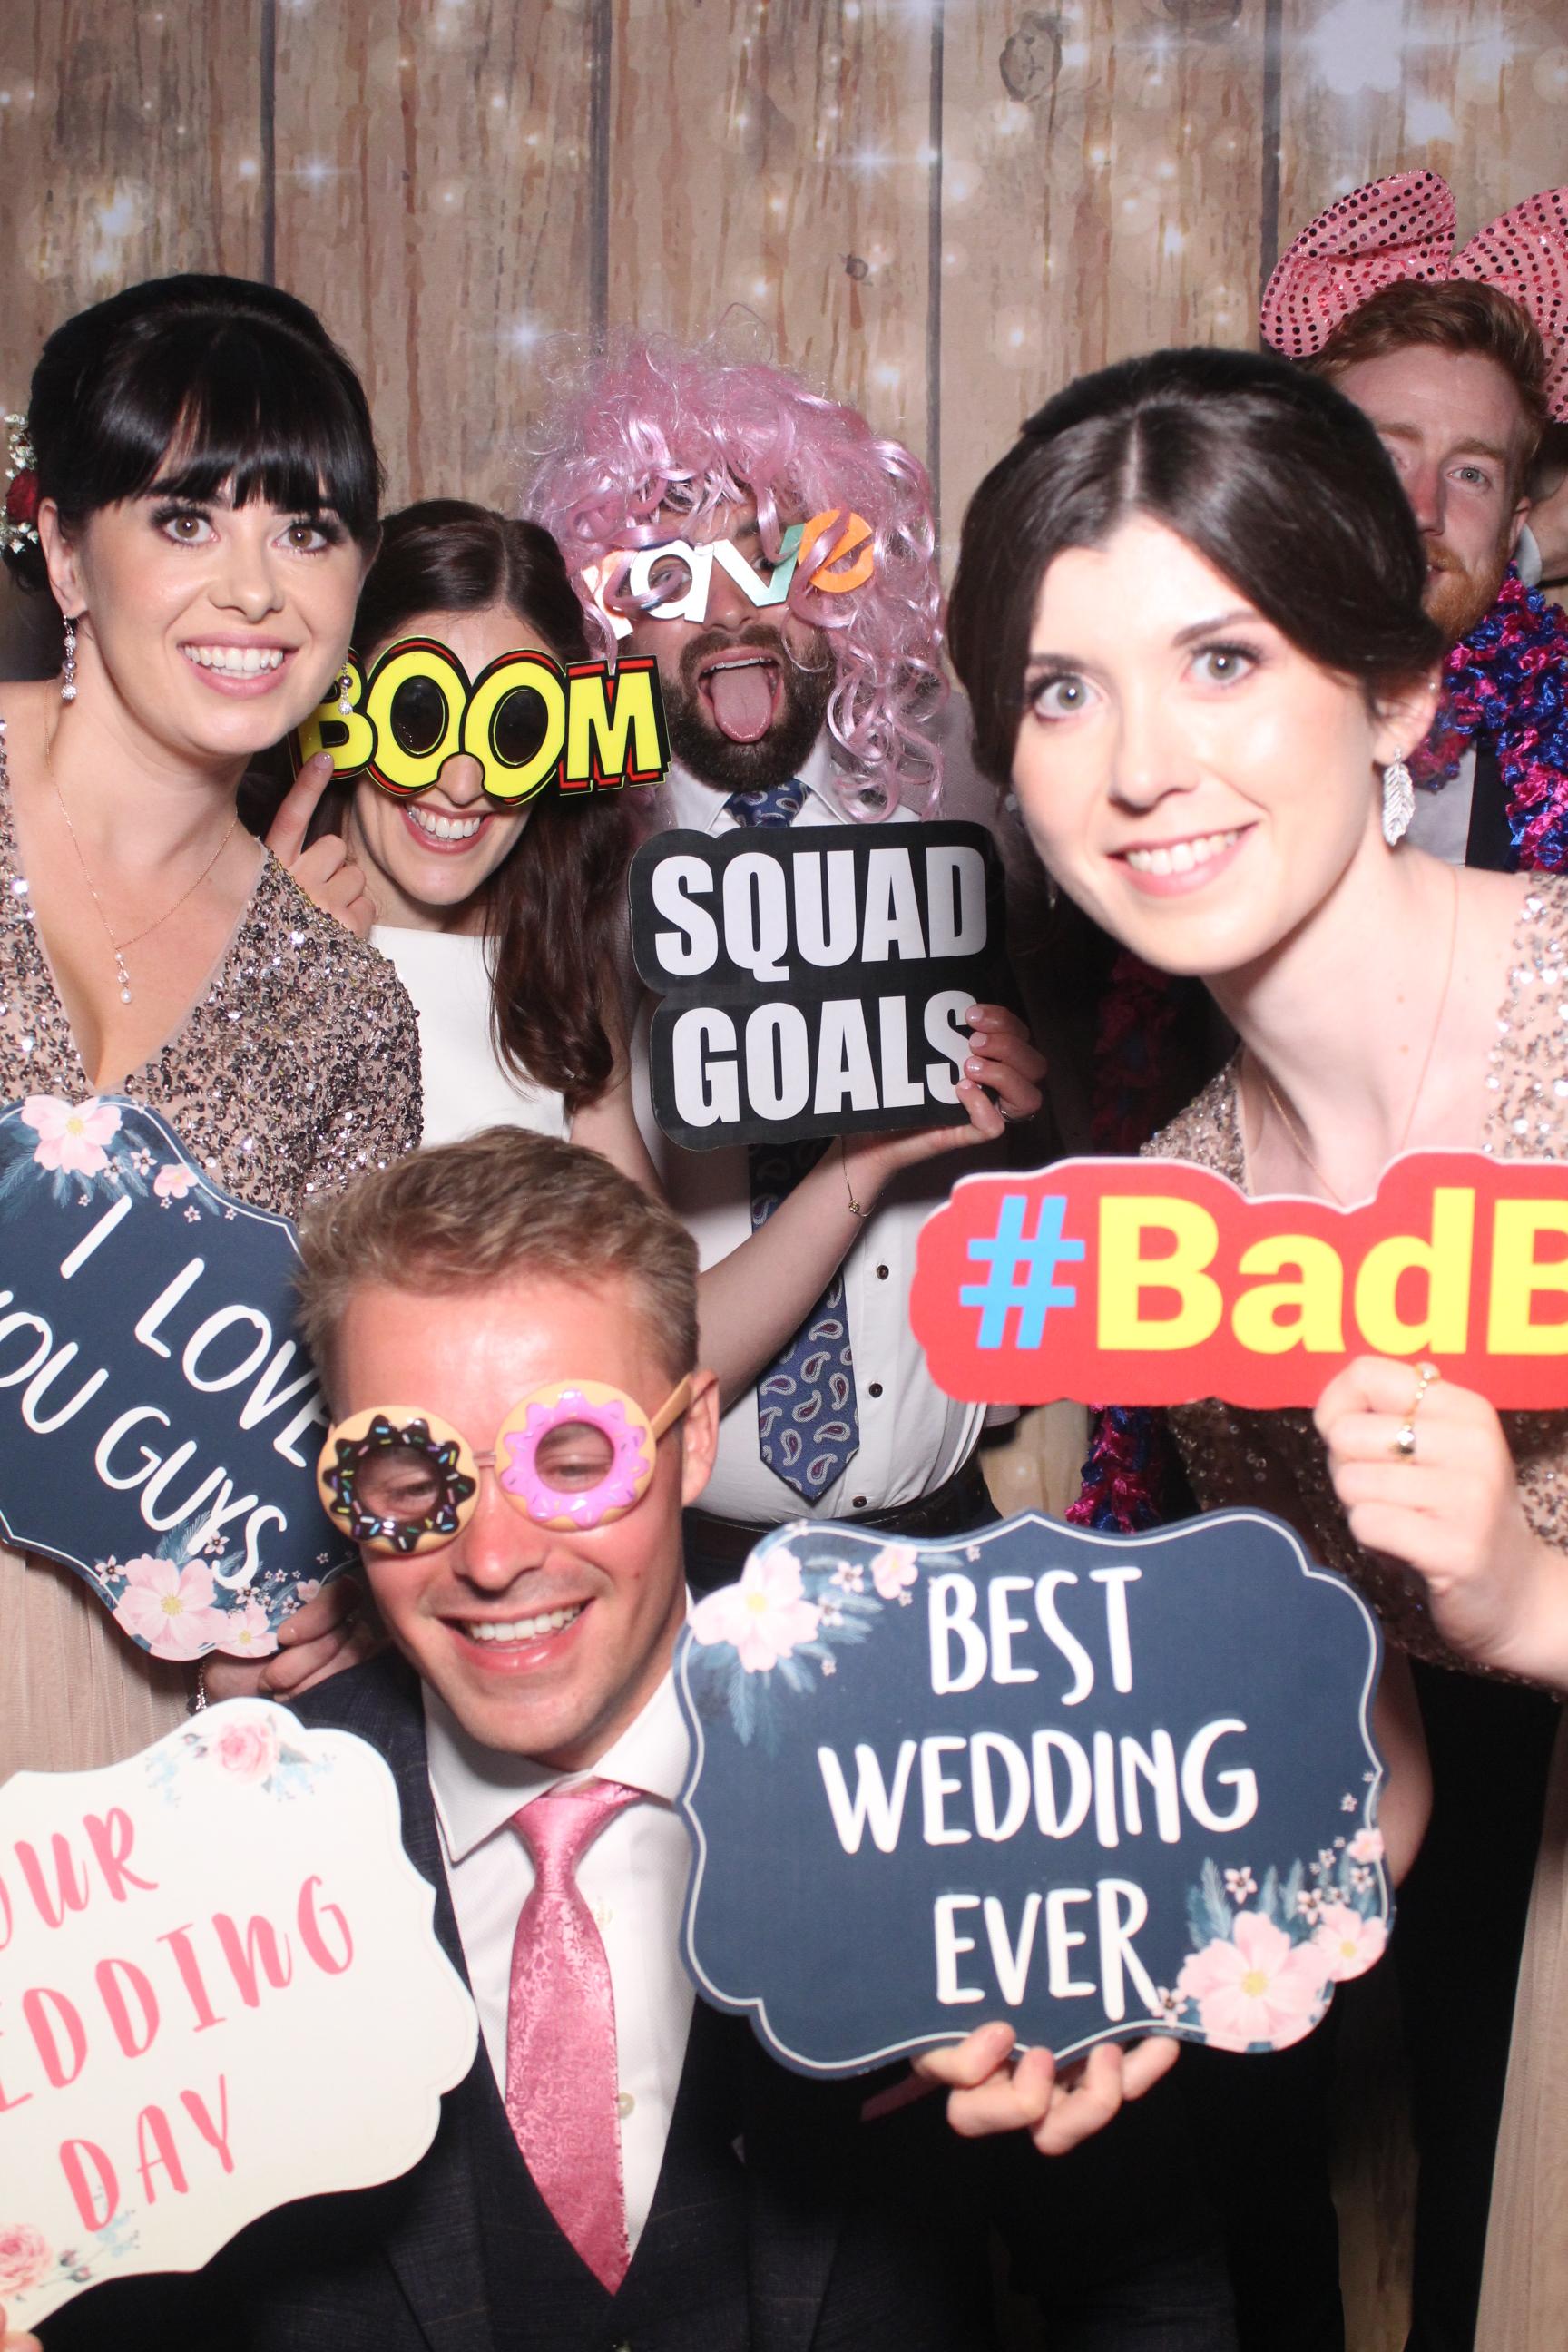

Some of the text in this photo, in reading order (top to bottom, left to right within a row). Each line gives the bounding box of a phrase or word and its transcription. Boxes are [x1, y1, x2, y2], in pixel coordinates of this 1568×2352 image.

[290, 635, 670, 804] BOOM
[652, 846, 988, 983] SQUAD
[672, 990, 980, 1128] GOALS
[60, 1194, 133, 1280] I
[0, 1289, 288, 1591] OU GUYS
[928, 1565, 1142, 1706] BEST
[817, 1718, 1259, 1854] WEDDING
[0, 1874, 355, 2113] DDING
[934, 1877, 1163, 2021] EVER
[58, 2073, 235, 2233] DAY
